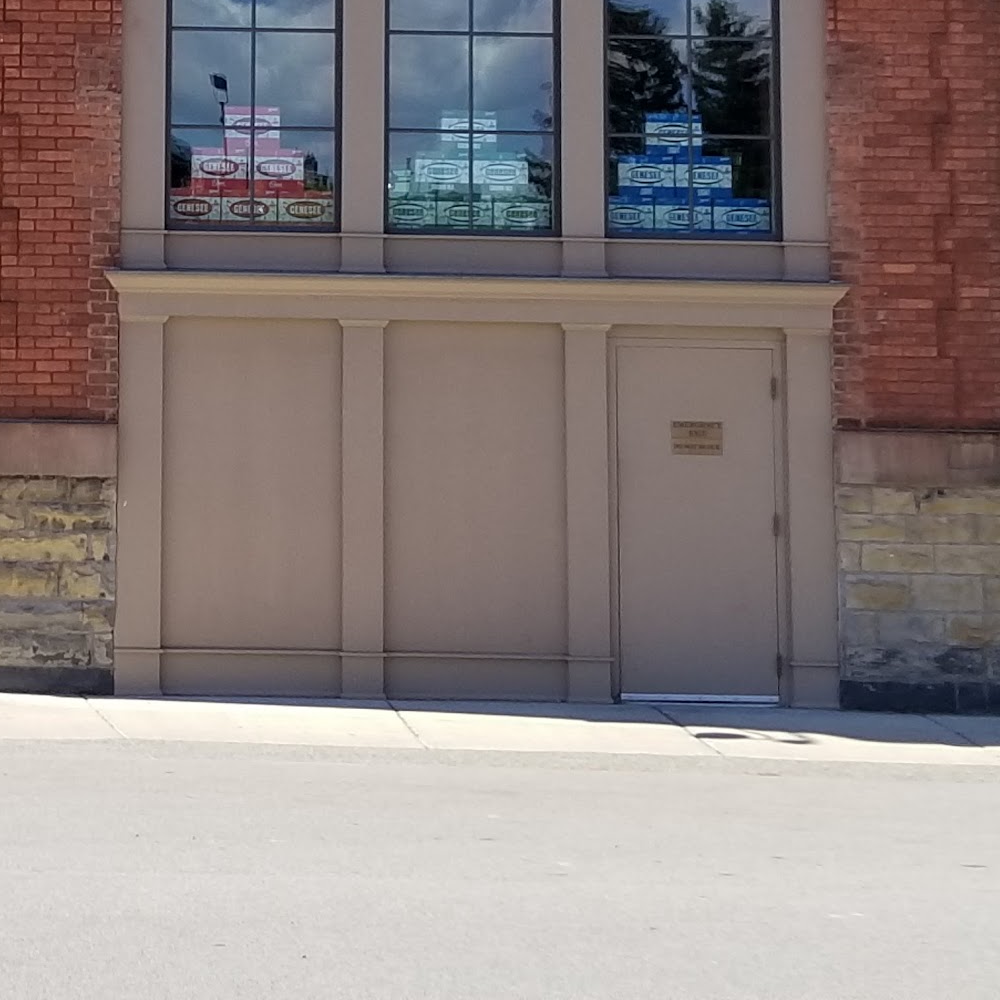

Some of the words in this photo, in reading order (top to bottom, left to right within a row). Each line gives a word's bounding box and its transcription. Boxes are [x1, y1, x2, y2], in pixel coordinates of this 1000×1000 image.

[689, 171, 719, 180] ENESEE
[177, 203, 209, 213] GENESEE
[289, 205, 322, 214] GENESEE
